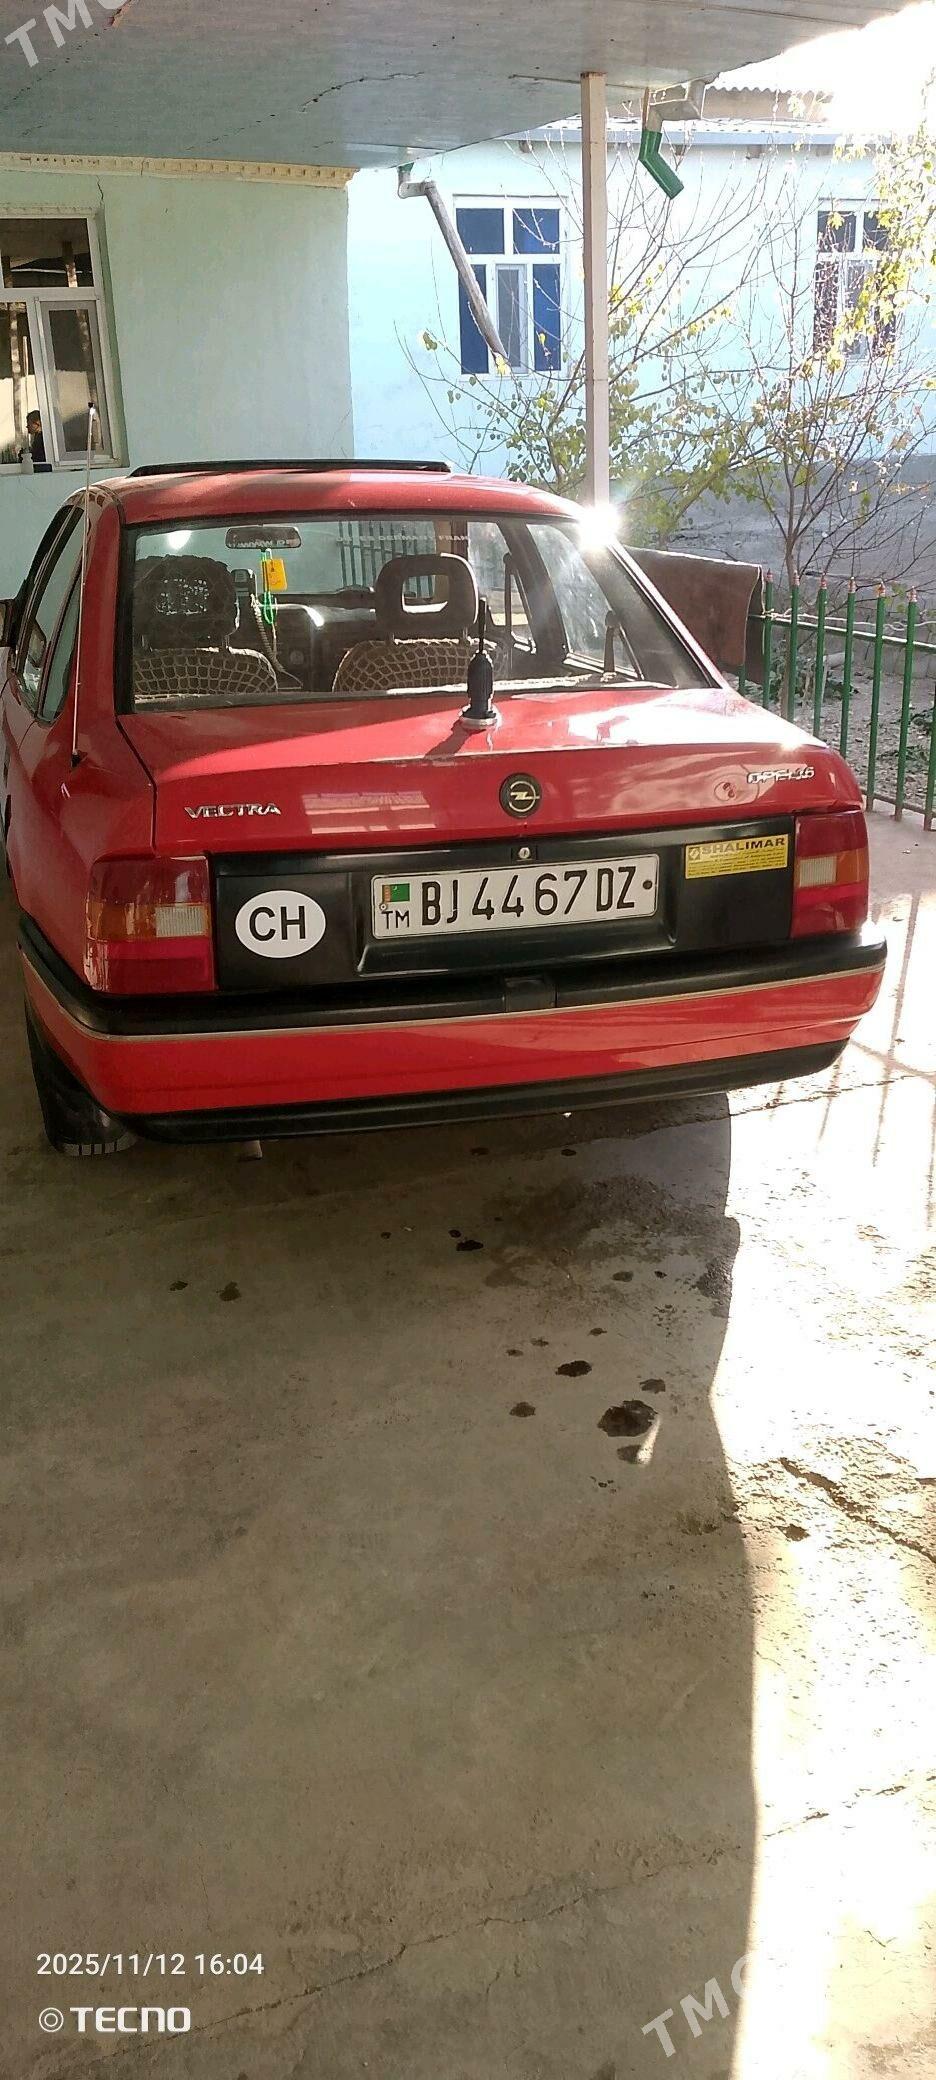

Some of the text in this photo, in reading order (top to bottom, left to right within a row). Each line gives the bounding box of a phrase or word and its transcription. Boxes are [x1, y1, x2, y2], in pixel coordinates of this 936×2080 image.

[184, 803, 282, 819] VECTRA
[701, 837, 786, 855] SHALIMAR
[249, 905, 307, 942] CH
[381, 909, 410, 930] TM
